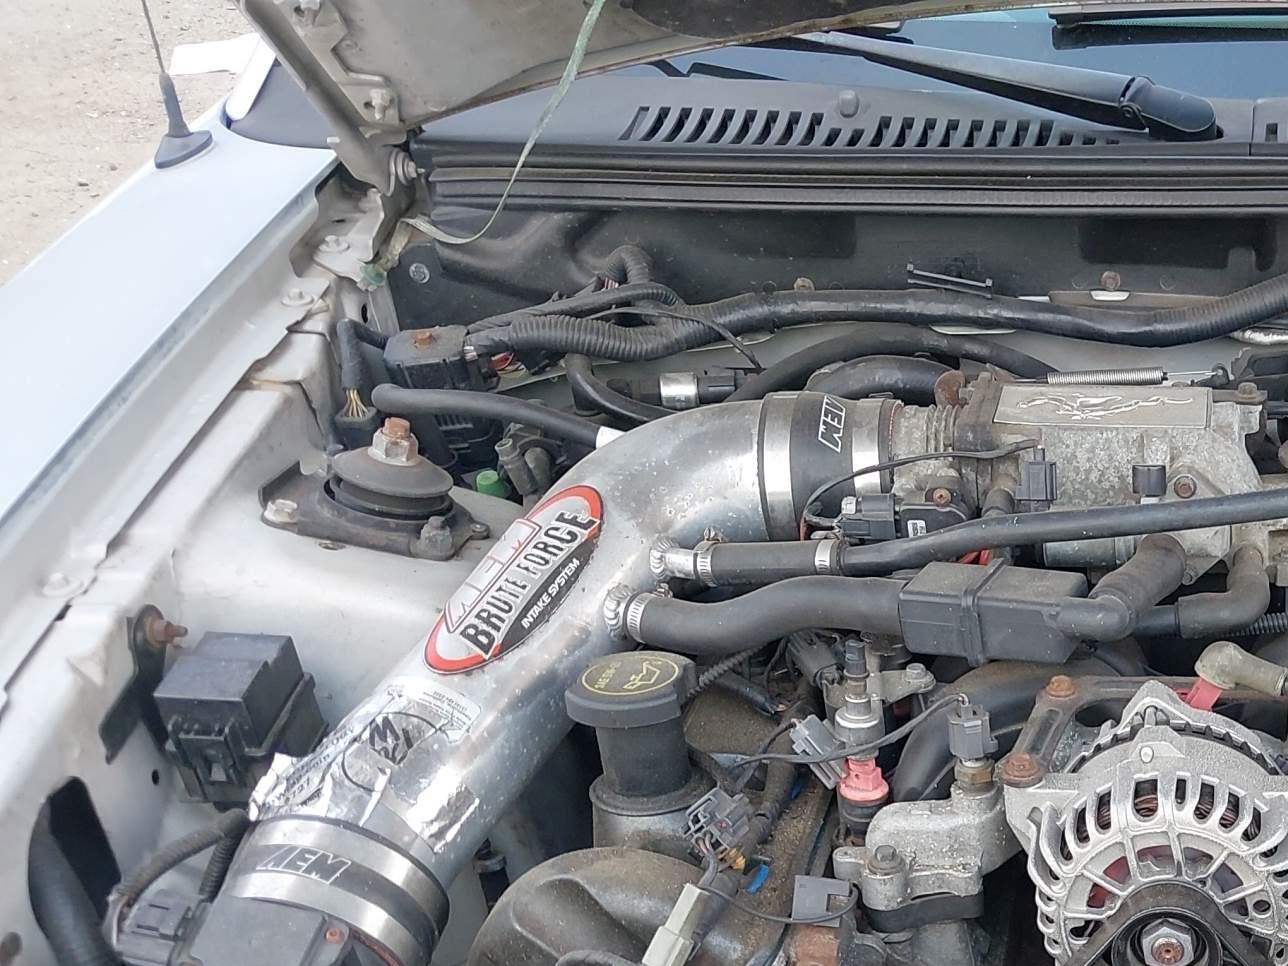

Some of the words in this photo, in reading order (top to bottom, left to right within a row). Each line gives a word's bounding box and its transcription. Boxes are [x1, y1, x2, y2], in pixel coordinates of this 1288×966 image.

[818, 394, 846, 453] AEM
[459, 577, 531, 659] BRUTE
[517, 511, 600, 579] FORCE
[520, 592, 551, 629] INTAKE
[547, 557, 580, 596] SYSTEM
[256, 846, 352, 885] AEM
